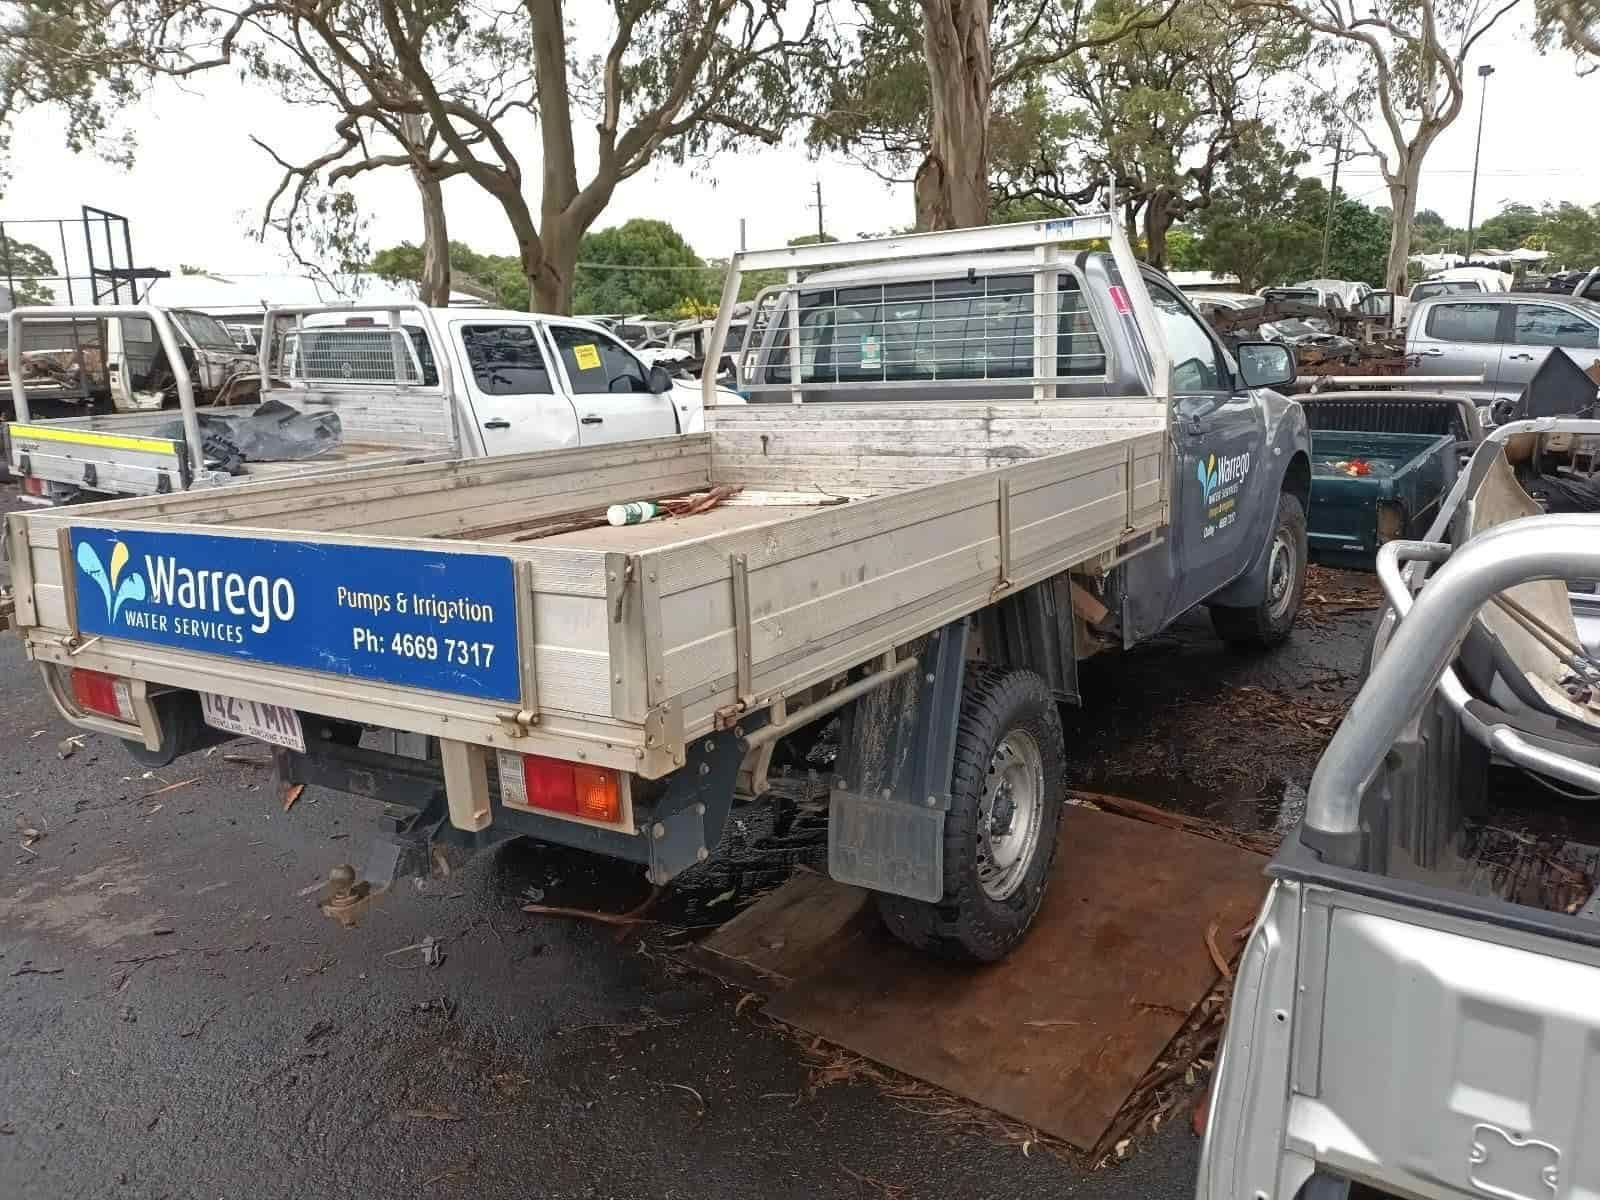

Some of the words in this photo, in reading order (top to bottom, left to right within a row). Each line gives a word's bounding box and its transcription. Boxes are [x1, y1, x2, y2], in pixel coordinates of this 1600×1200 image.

[1217, 452, 1250, 486] Warrego
[144, 554, 295, 634] Warrego
[336, 586, 391, 616] Pumps
[396, 592, 408, 614] &
[413, 593, 494, 624] Irrigation
[125, 609, 168, 632] WATER
[174, 617, 243, 643] SERVICES
[352, 627, 385, 654] Ph:
[391, 632, 438, 661] 4669
[444, 638, 495, 669] 7317
